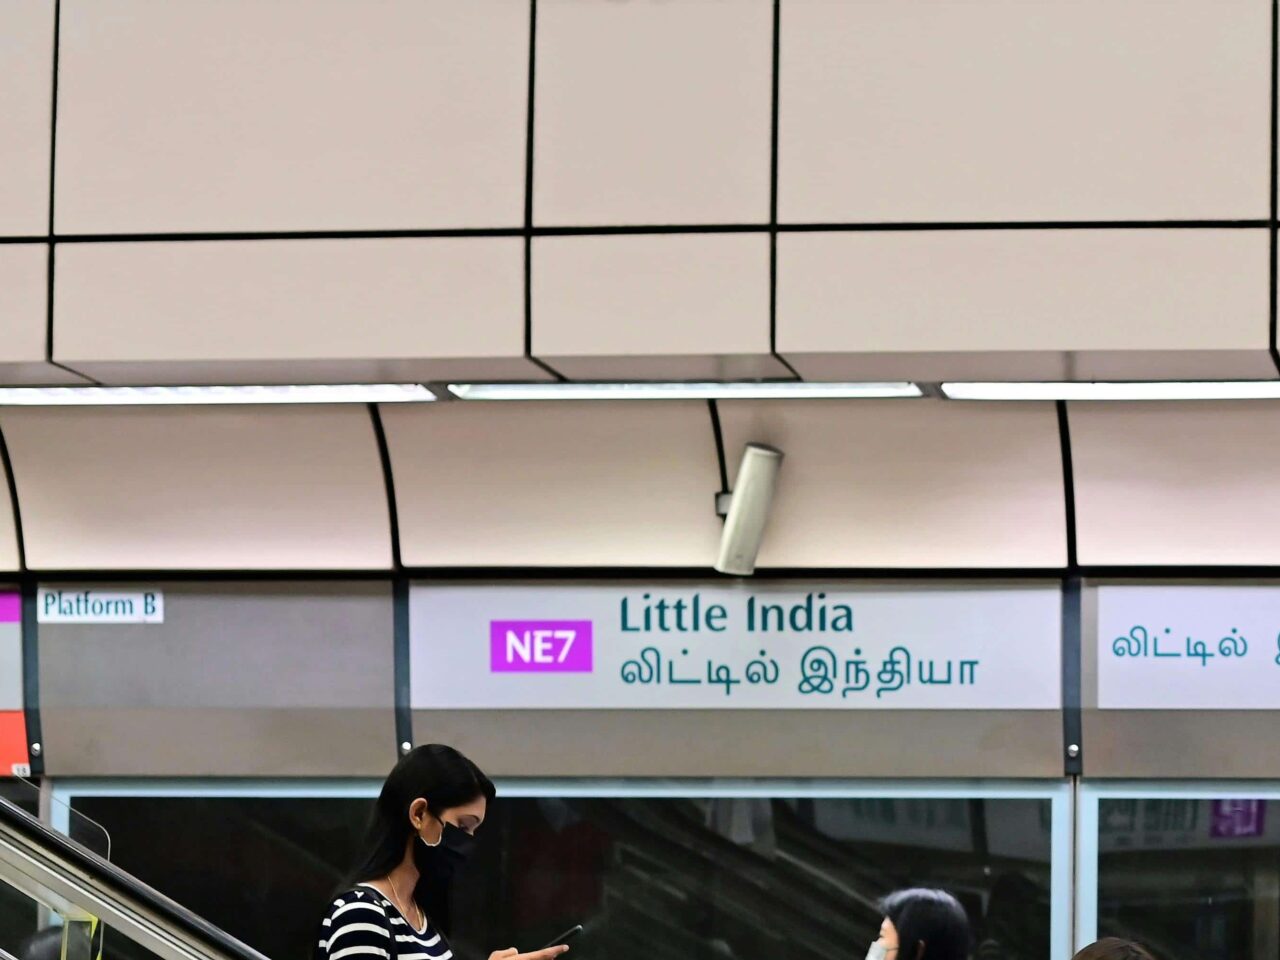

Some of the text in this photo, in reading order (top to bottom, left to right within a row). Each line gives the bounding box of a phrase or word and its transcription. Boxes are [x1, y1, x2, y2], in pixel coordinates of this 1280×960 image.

[44, 592, 157, 615] Platform B
[621, 592, 853, 632] Little India
[506, 630, 577, 663] NE7
[1112, 626, 1248, 667] லிட்டில்
[620, 646, 979, 698] லிட்டில் இந்தியா
